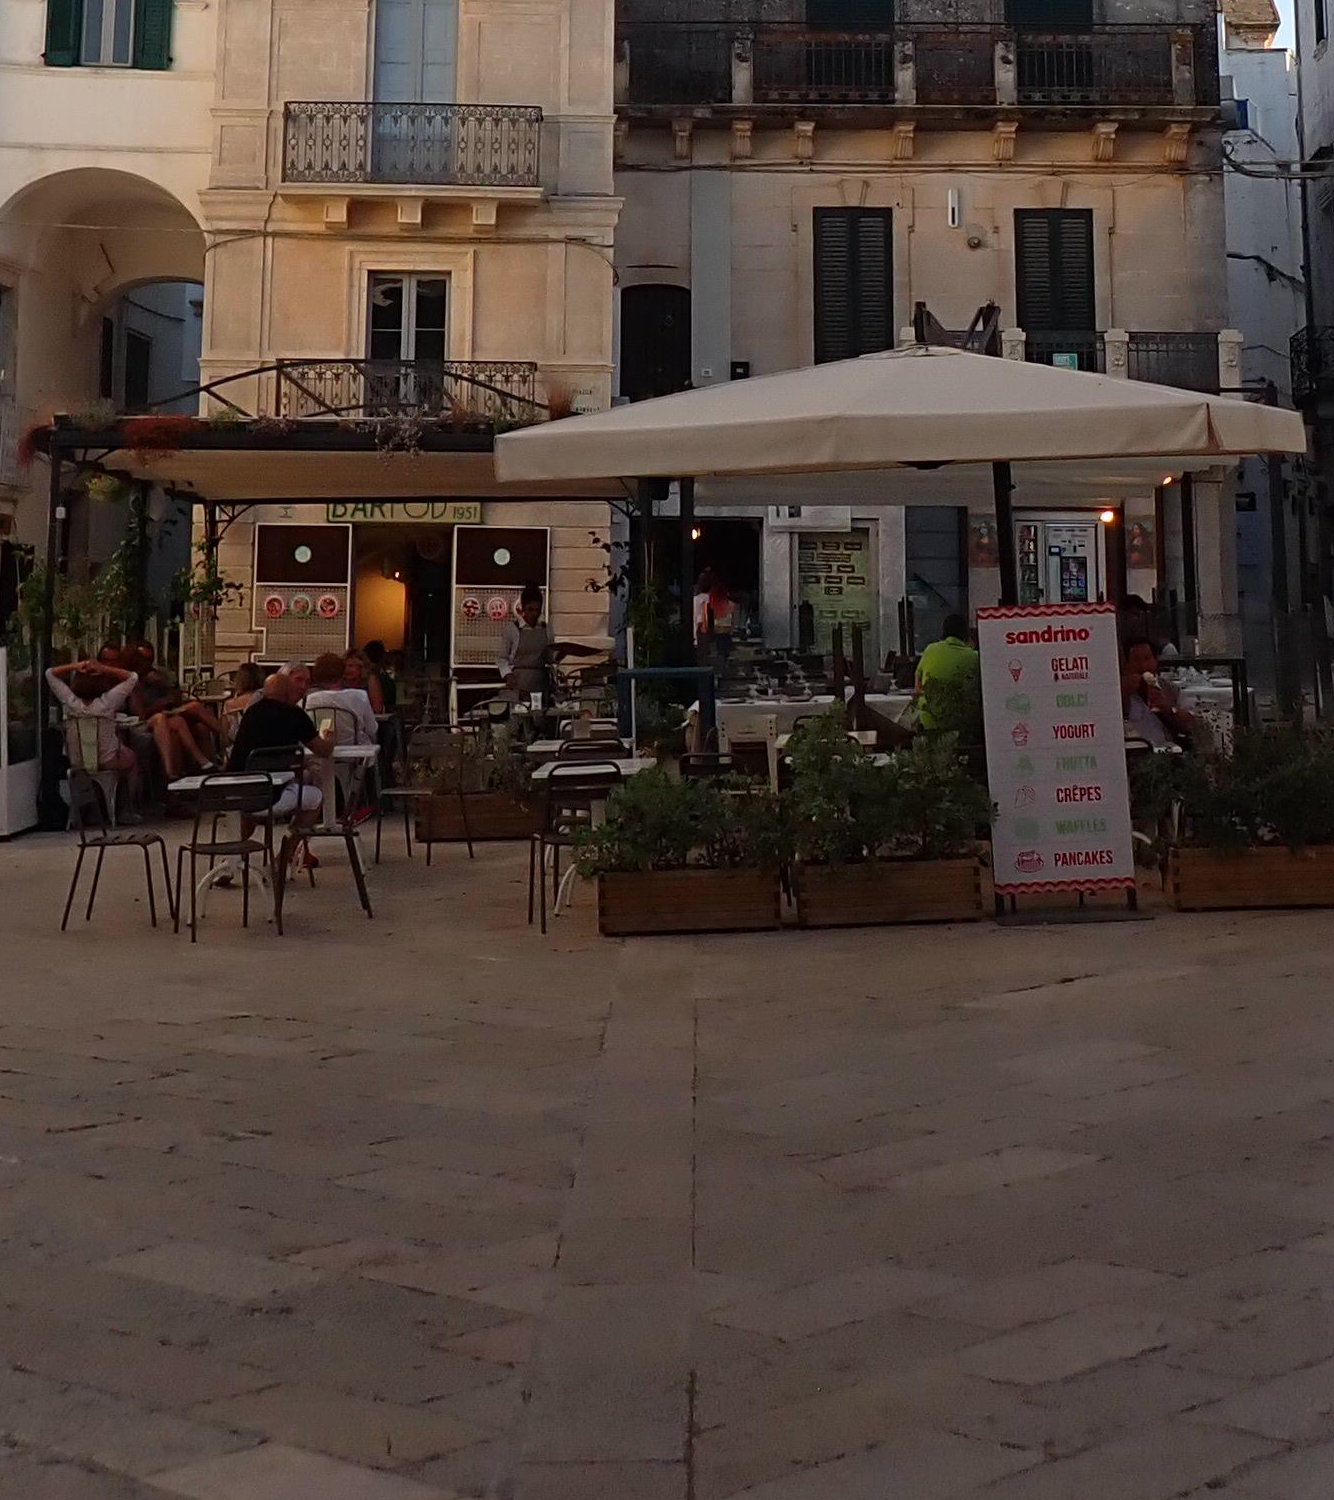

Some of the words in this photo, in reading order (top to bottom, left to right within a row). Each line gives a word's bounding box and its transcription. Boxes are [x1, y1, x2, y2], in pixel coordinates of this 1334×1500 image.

[453, 506, 478, 520] 1951
[1006, 625, 1090, 644] sandrino
[1051, 657, 1089, 672] GELATI
[1056, 693, 1089, 708] DOLCI
[1053, 724, 1095, 739] YOGURT
[1056, 756, 1098, 771] FRUTTA
[1056, 784, 1102, 803] CRÊPES
[1055, 819, 1107, 835] WAFFLES
[1054, 850, 1114, 867] PANCAKES
